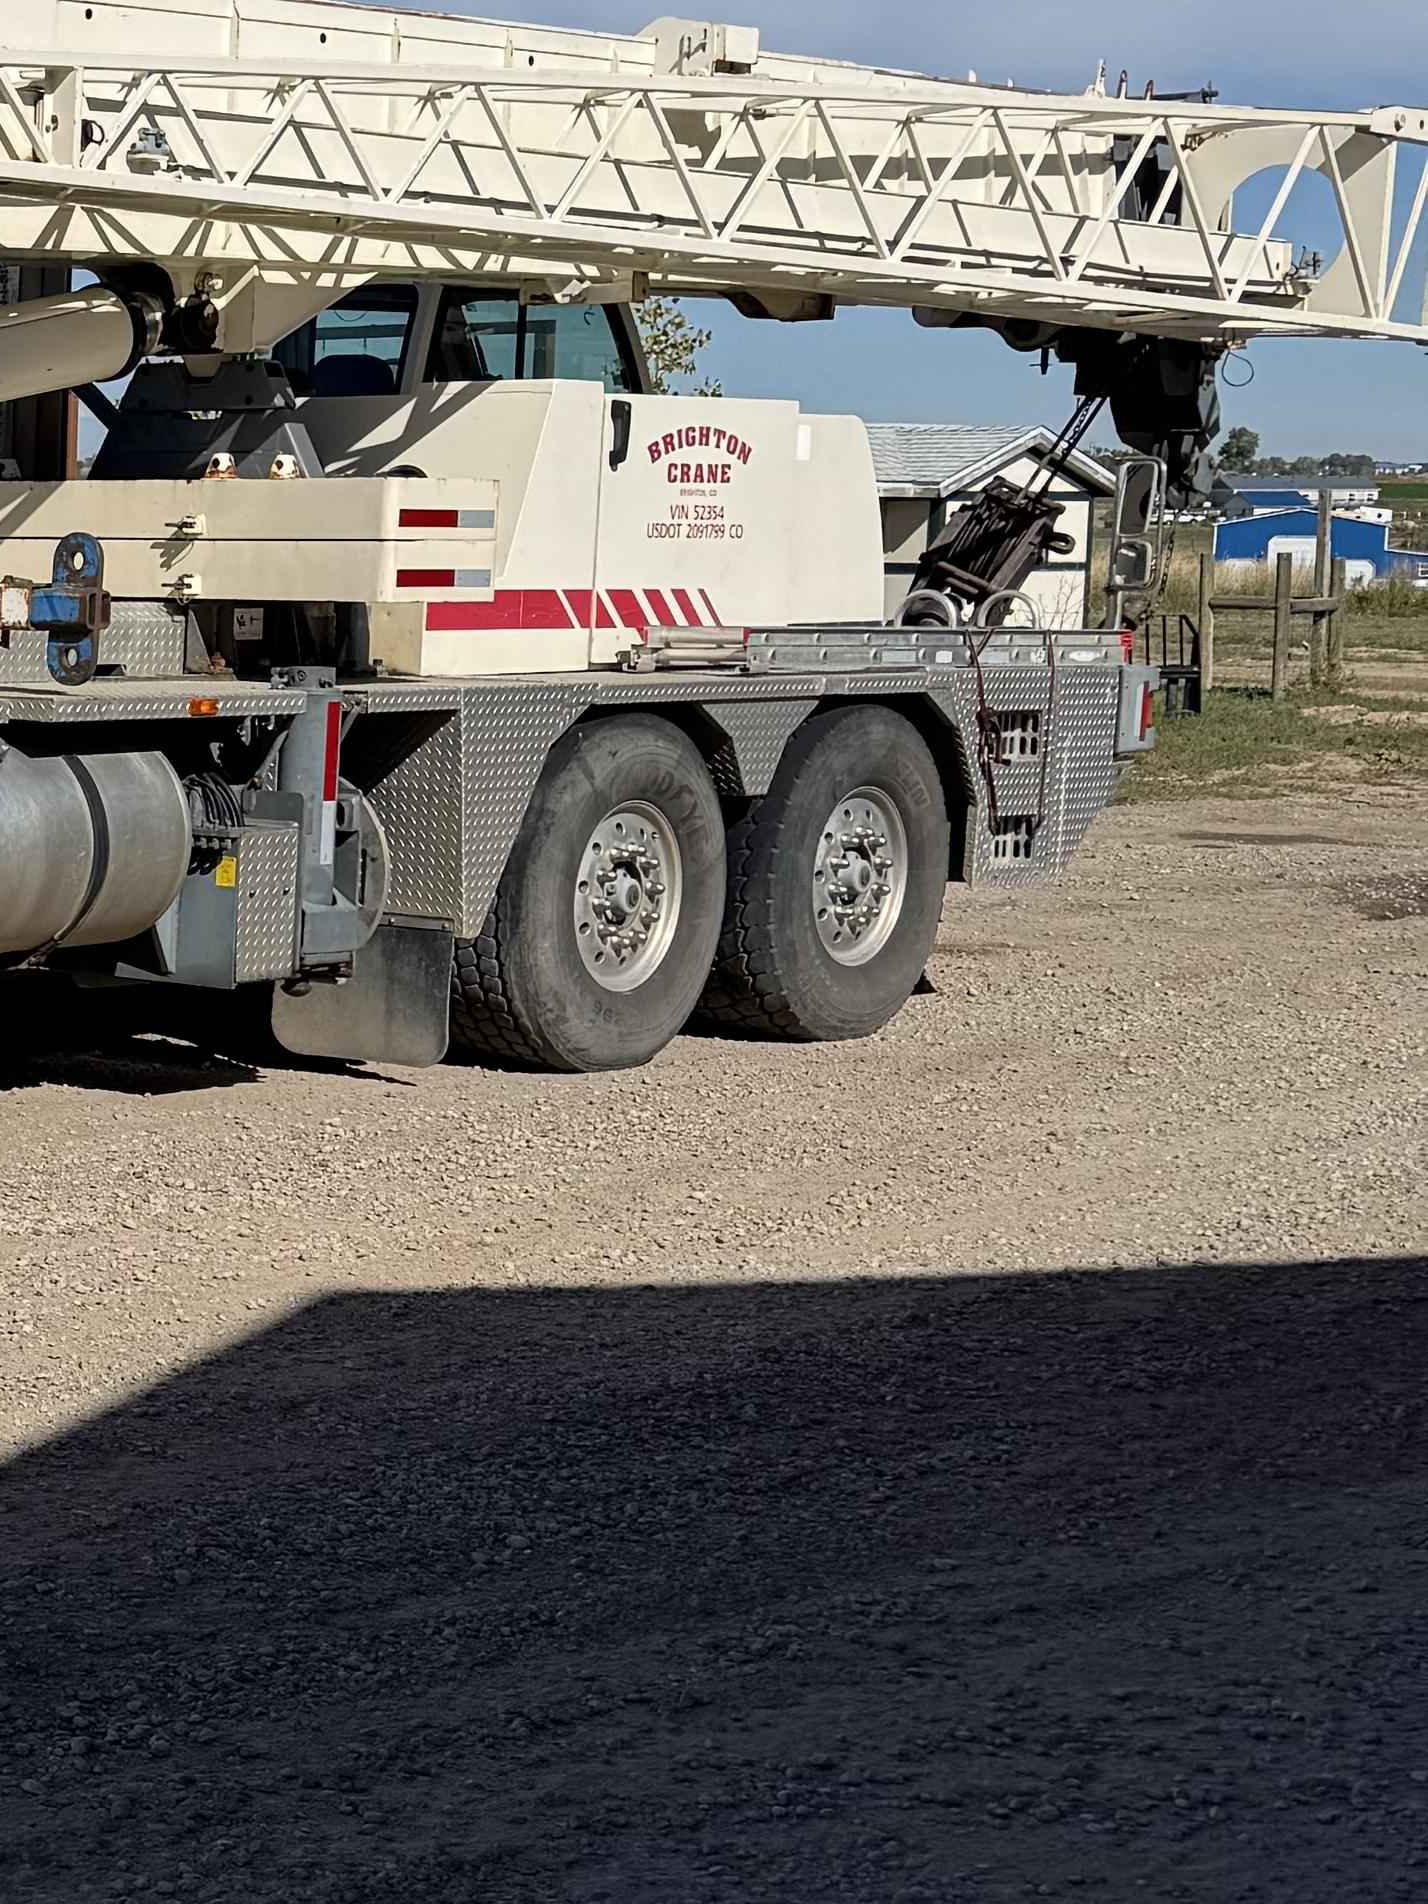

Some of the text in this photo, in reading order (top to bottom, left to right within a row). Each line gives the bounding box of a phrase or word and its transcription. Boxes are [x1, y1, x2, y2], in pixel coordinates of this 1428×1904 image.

[647, 425, 752, 465] BRIGHTON
[667, 462, 732, 484] CRANE
[670, 504, 689, 520] VIN
[646, 523, 682, 539] USDOT
[728, 523, 744, 539] CO
